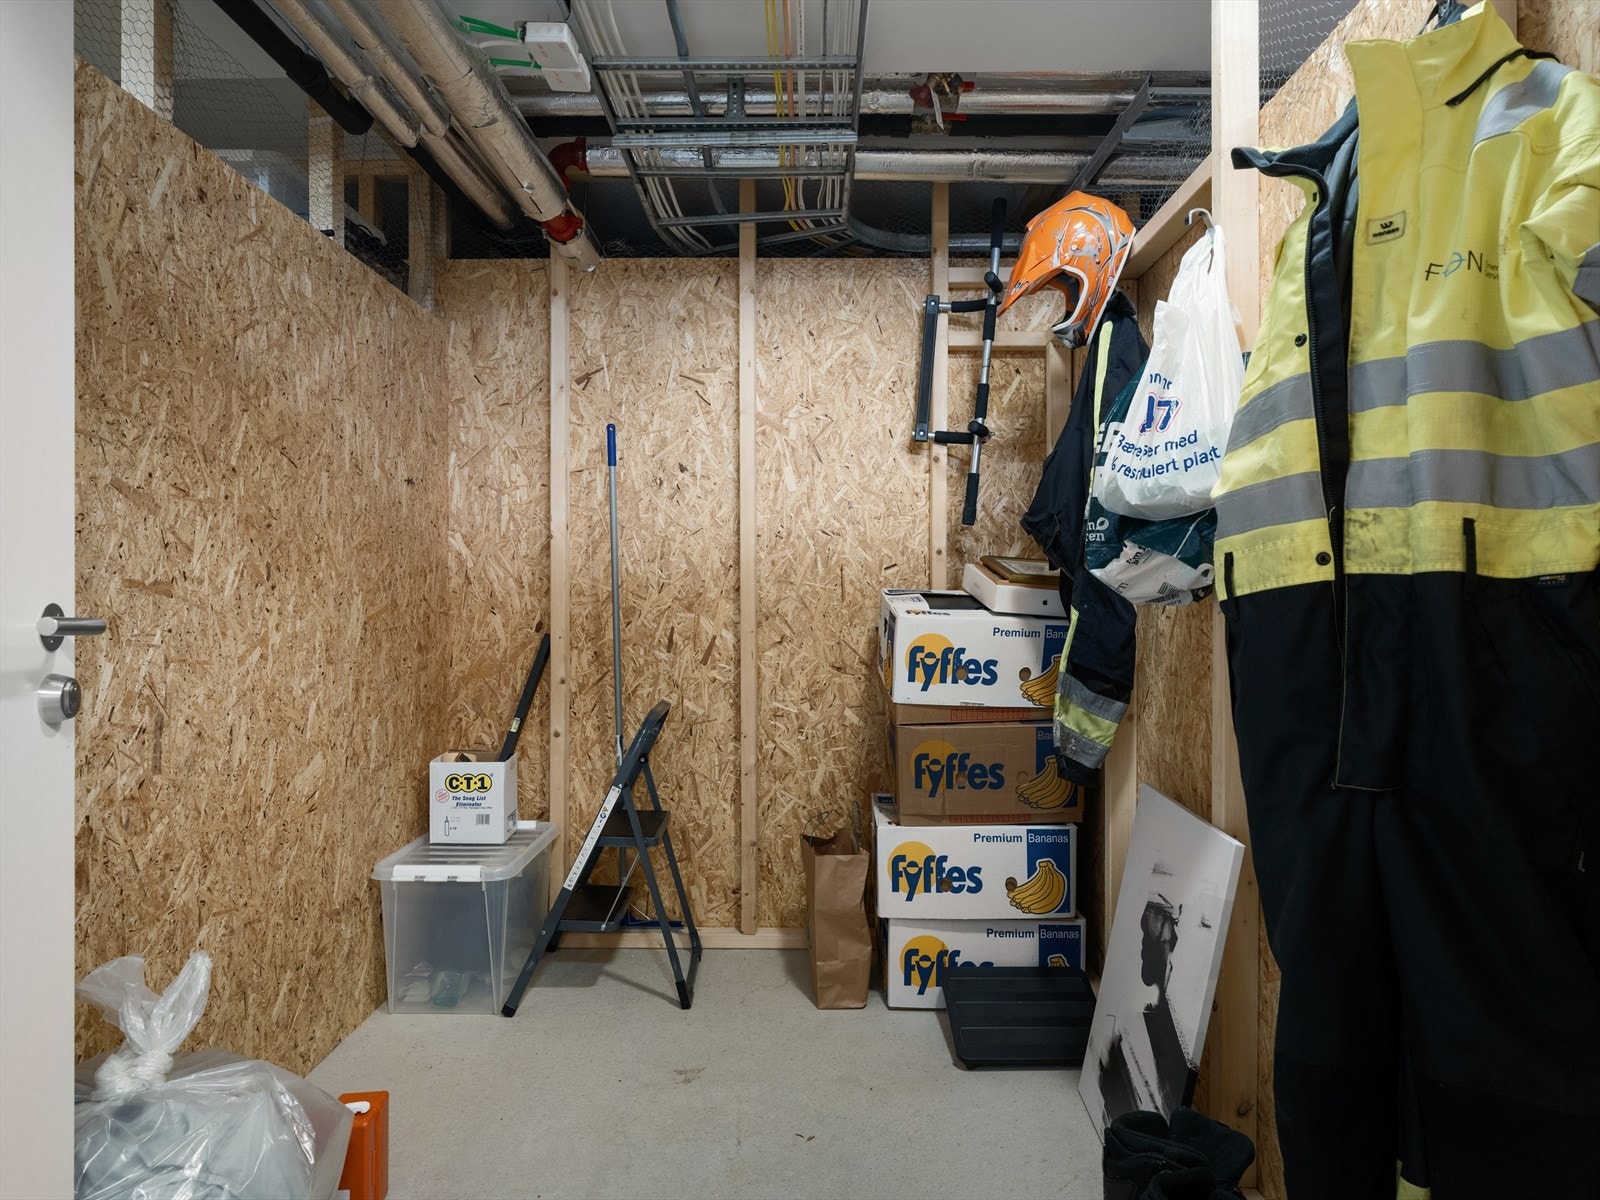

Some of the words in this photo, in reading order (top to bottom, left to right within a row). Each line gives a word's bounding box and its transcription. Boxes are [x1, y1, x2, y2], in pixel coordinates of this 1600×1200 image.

[992, 627, 1041, 638] Premium
[1046, 628, 1068, 639] Bana
[908, 645, 998, 692] fyffes
[914, 752, 1005, 798] fyffes
[973, 833, 1023, 843] Premium
[1028, 833, 1069, 843] Bananas
[891, 854, 983, 902] fyffes
[986, 928, 1035, 939] Premium
[1040, 929, 1080, 939] Bananas
